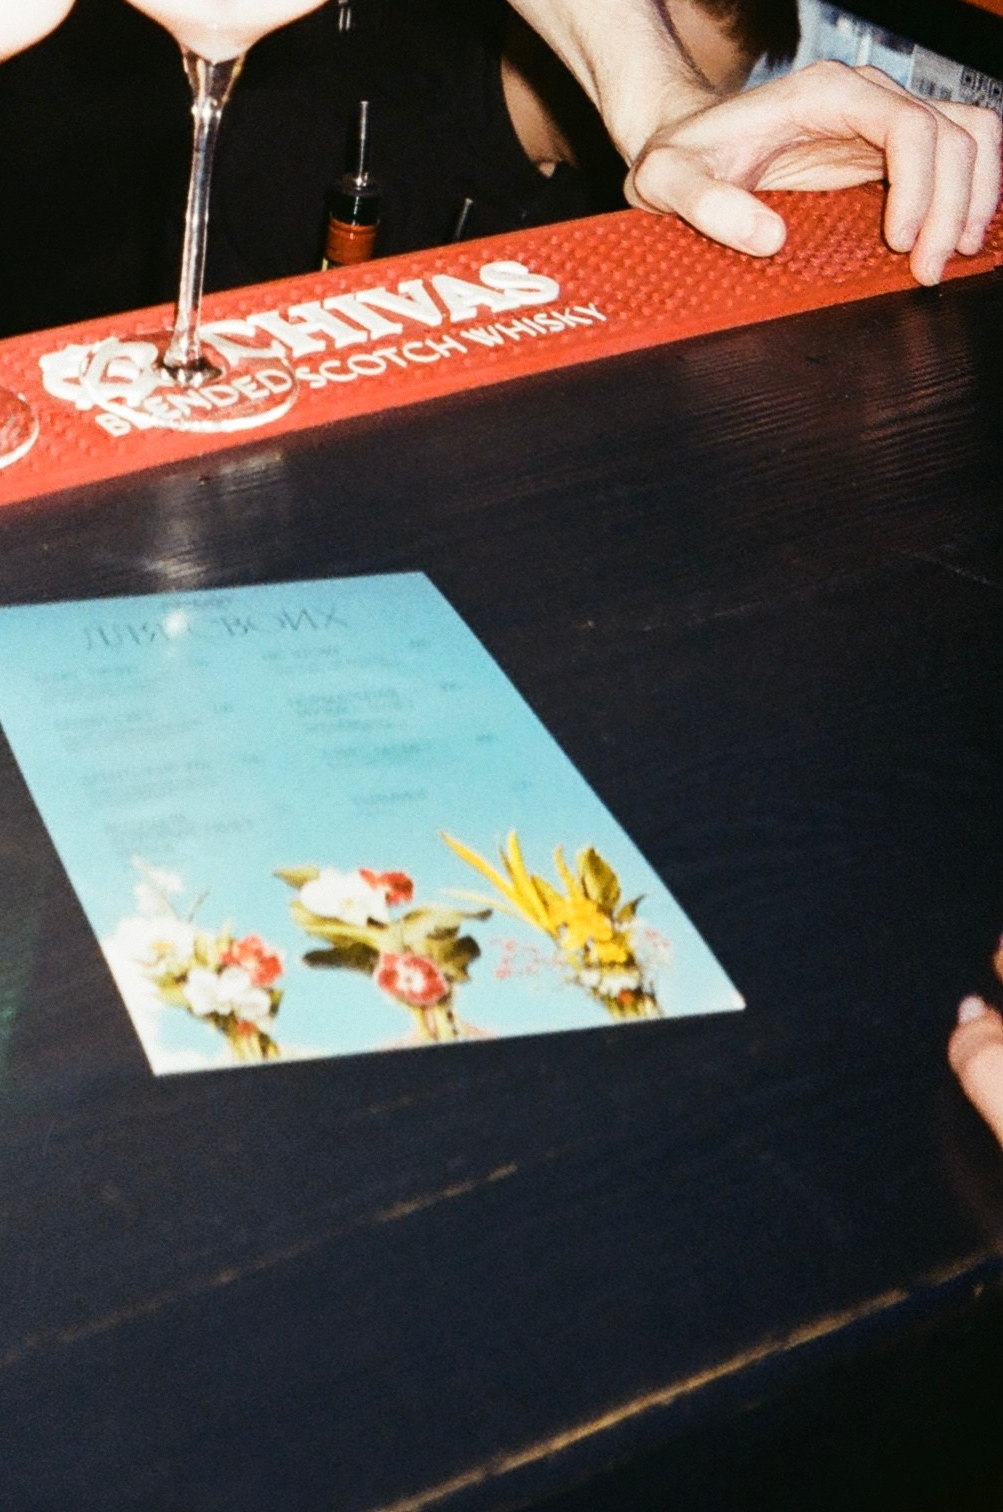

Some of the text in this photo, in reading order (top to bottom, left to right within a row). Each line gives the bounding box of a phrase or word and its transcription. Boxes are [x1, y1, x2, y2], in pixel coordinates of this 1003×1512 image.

[195, 260, 560, 366] CHIVAS
[297, 335, 467, 390] SCOTCH
[460, 302, 608, 349] WHISKY
